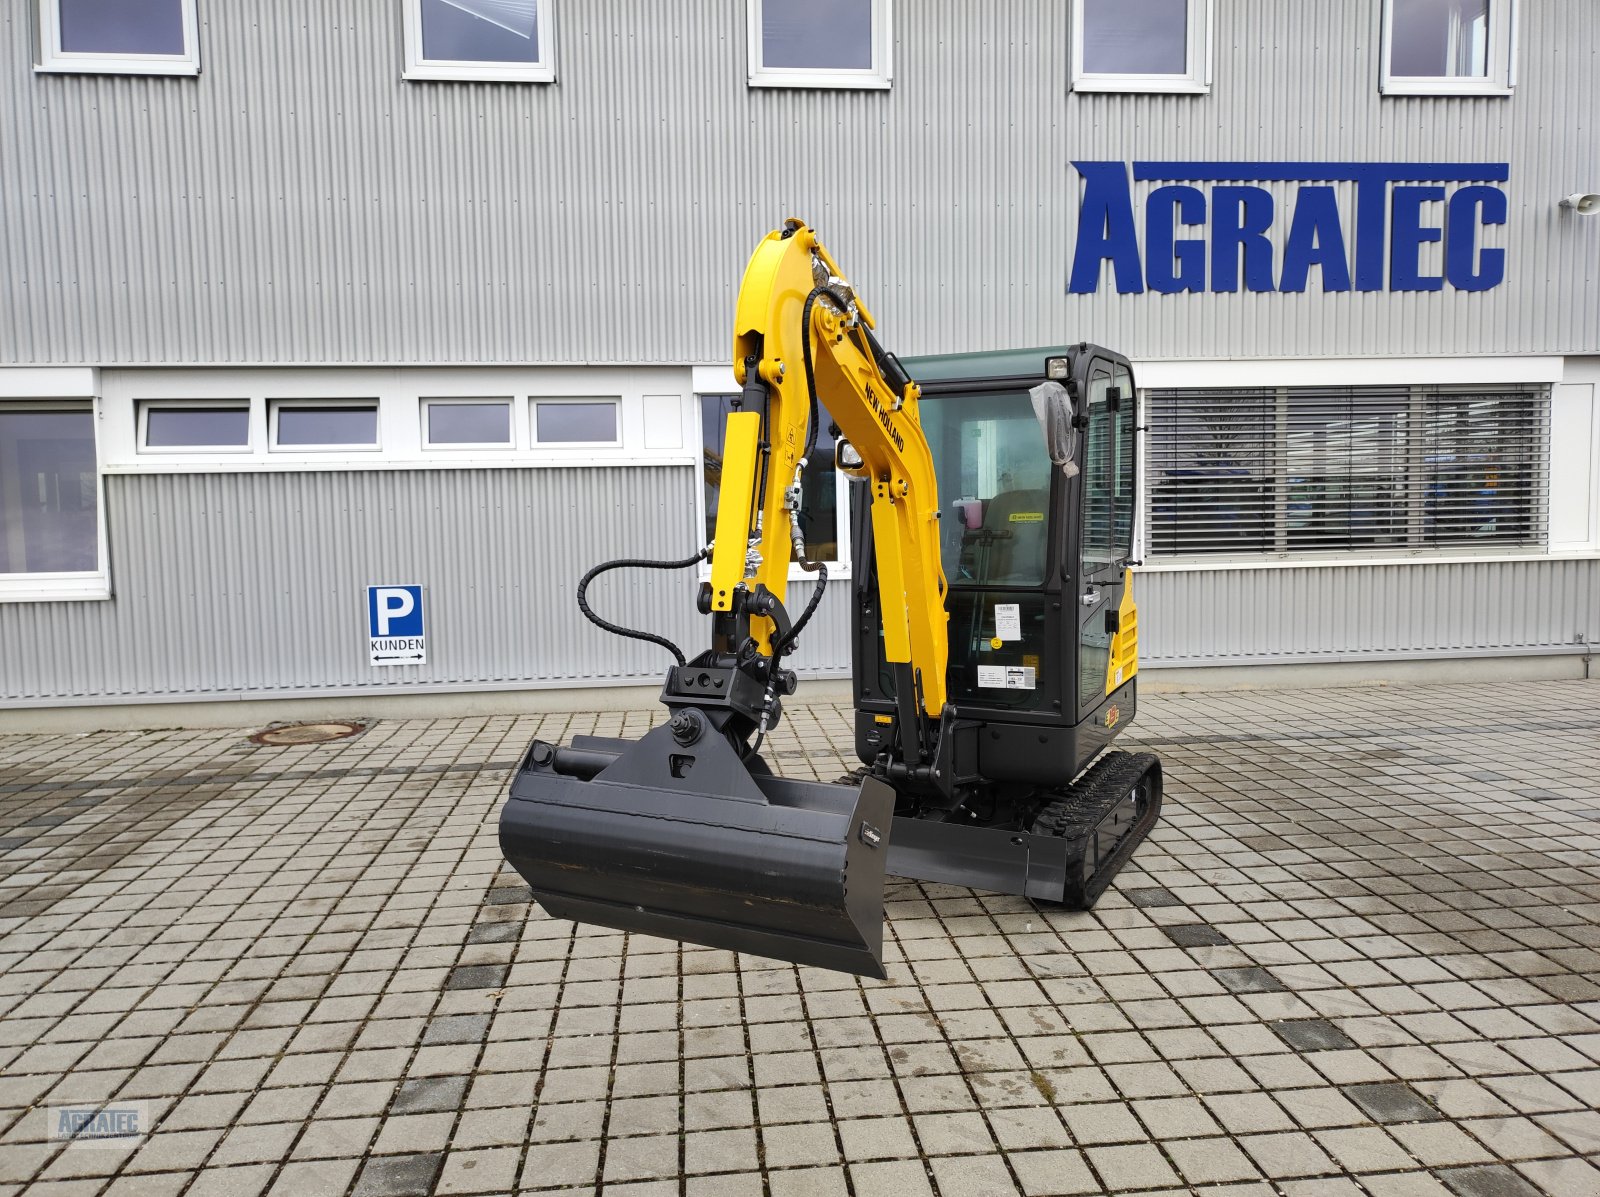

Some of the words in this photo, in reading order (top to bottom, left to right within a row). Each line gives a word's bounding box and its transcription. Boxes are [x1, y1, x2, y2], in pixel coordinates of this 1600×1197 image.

[1068, 161, 1509, 293] AGRATEC
[865, 382, 879, 413] NEW
[879, 405, 904, 453] HOLLAND
[376, 588, 414, 635] P
[371, 639, 424, 651] KUNDEN
